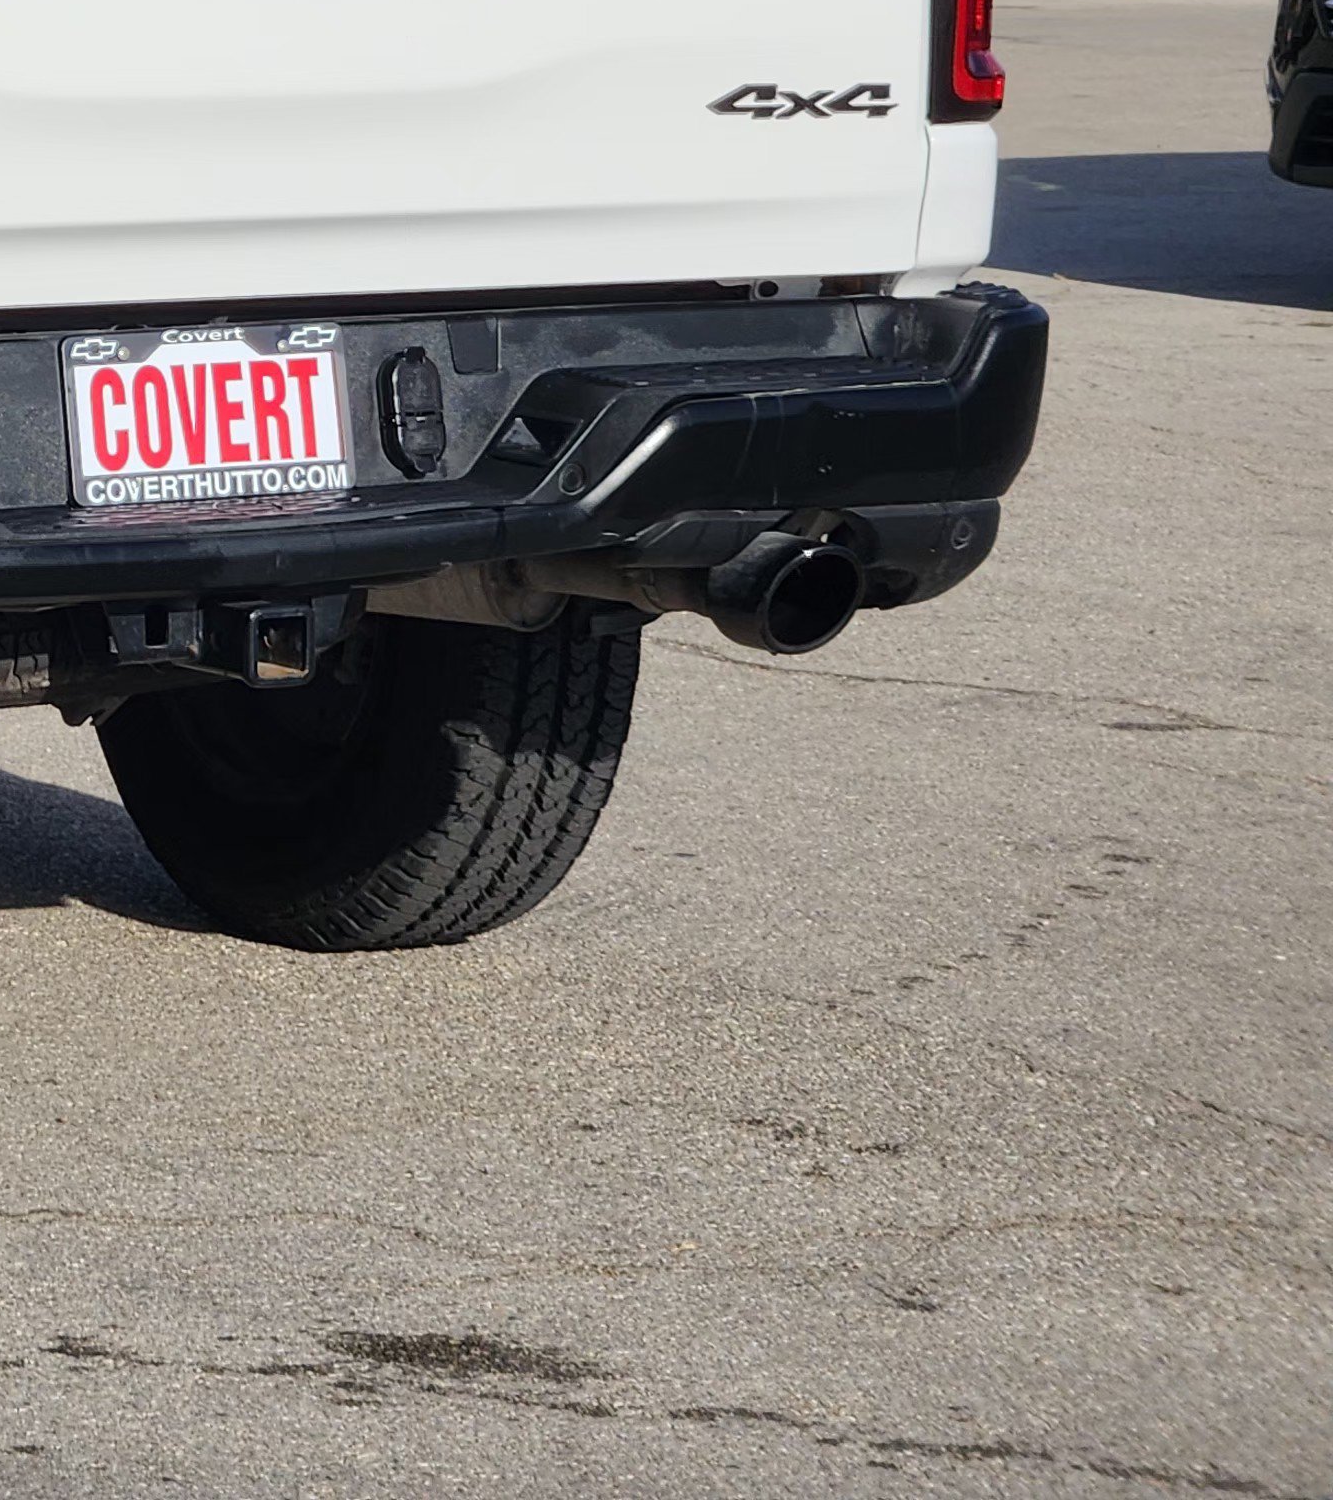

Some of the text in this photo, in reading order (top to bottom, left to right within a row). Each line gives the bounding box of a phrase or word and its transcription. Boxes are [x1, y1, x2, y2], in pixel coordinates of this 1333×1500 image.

[706, 83, 899, 120] 4x4
[160, 327, 245, 344] Covert
[89, 357, 320, 472] COVERT
[86, 464, 349, 506] COVERTHUTTO.COM
